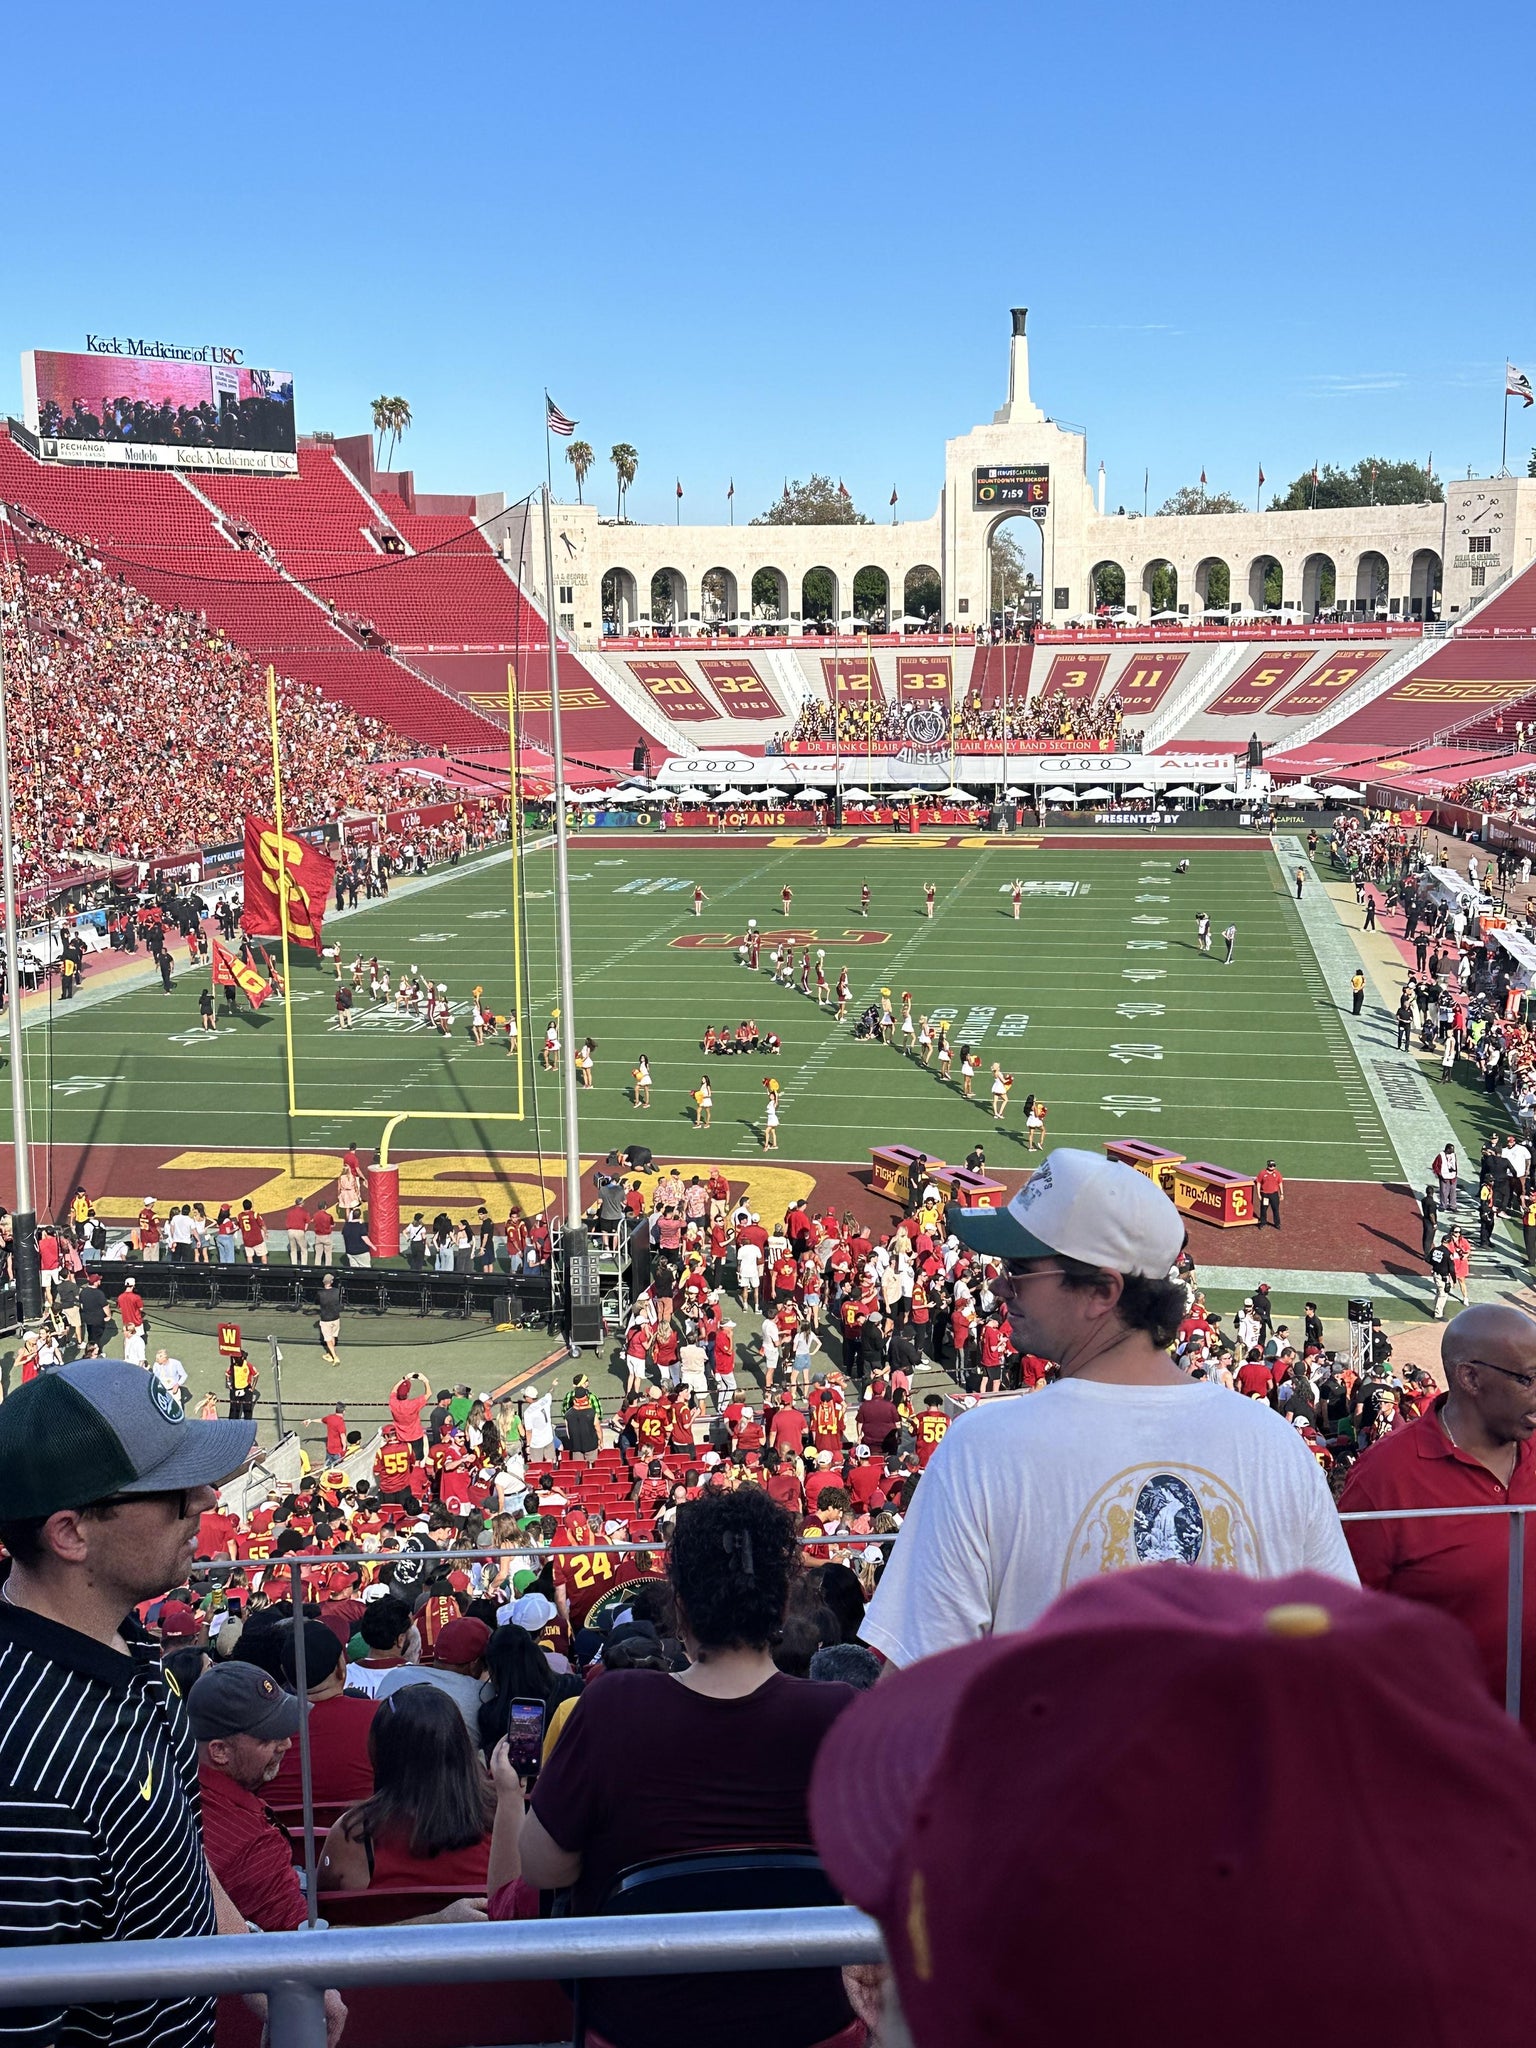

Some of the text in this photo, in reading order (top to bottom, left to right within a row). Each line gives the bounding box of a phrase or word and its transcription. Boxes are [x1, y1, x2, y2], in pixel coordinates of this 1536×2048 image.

[86, 334, 244, 365] Keck Medicine of USC
[60, 442, 105, 452] PECHANGA
[125, 447, 158, 462] Modelo
[177, 449, 295, 469] Keck Medicine of USC
[979, 487, 995, 501] O
[1001, 489, 1024, 499] 7:59
[1032, 484, 1044, 500] SC
[1033, 507, 1046, 517] 25
[645, 677, 695, 695] 20
[713, 676, 763, 693] 32
[836, 674, 872, 691] 12
[903, 673, 947, 689] 33
[1062, 670, 1087, 687] 3
[1129, 670, 1163, 687] 11
[1250, 669, 1284, 687] 5
[1309, 668, 1358, 687] 13
[667, 703, 706, 711] 1965
[826, 743, 858, 751] FRANK
[871, 743, 899, 751] BLAIR
[954, 742, 980, 750] BLAIR
[983, 742, 1016, 750] FAMLY
[1019, 742, 1047, 750] BAND
[1050, 742, 1091, 750] SECTION
[780, 762, 845, 772] Audi
[1160, 760, 1229, 769] Audi
[636, 813, 651, 826] O
[1164, 814, 1180, 824] BY
[767, 836, 1045, 849] USC
[953, 1005, 998, 1046] AIRLINES
[996, 1013, 1030, 1037] FIELD
[1108, 1043, 1164, 1060] 20
[1370, 1057, 1431, 1113] PROGRESSIVE
[1100, 1094, 1162, 1113] 10
[875, 1164, 909, 1190] FIGHT ON
[1179, 1183, 1222, 1208] TROJANS
[1232, 1189, 1248, 1217] SC
[242, 1219, 251, 1232] 6
[847, 1309, 855, 1324] 8
[222, 1328, 236, 1345] W
[641, 1418, 661, 1436] 42
[922, 1422, 947, 1443] 58
[383, 1452, 408, 1474] 55
[249, 1545, 270, 1561] 55
[569, 1551, 613, 1589] 24
